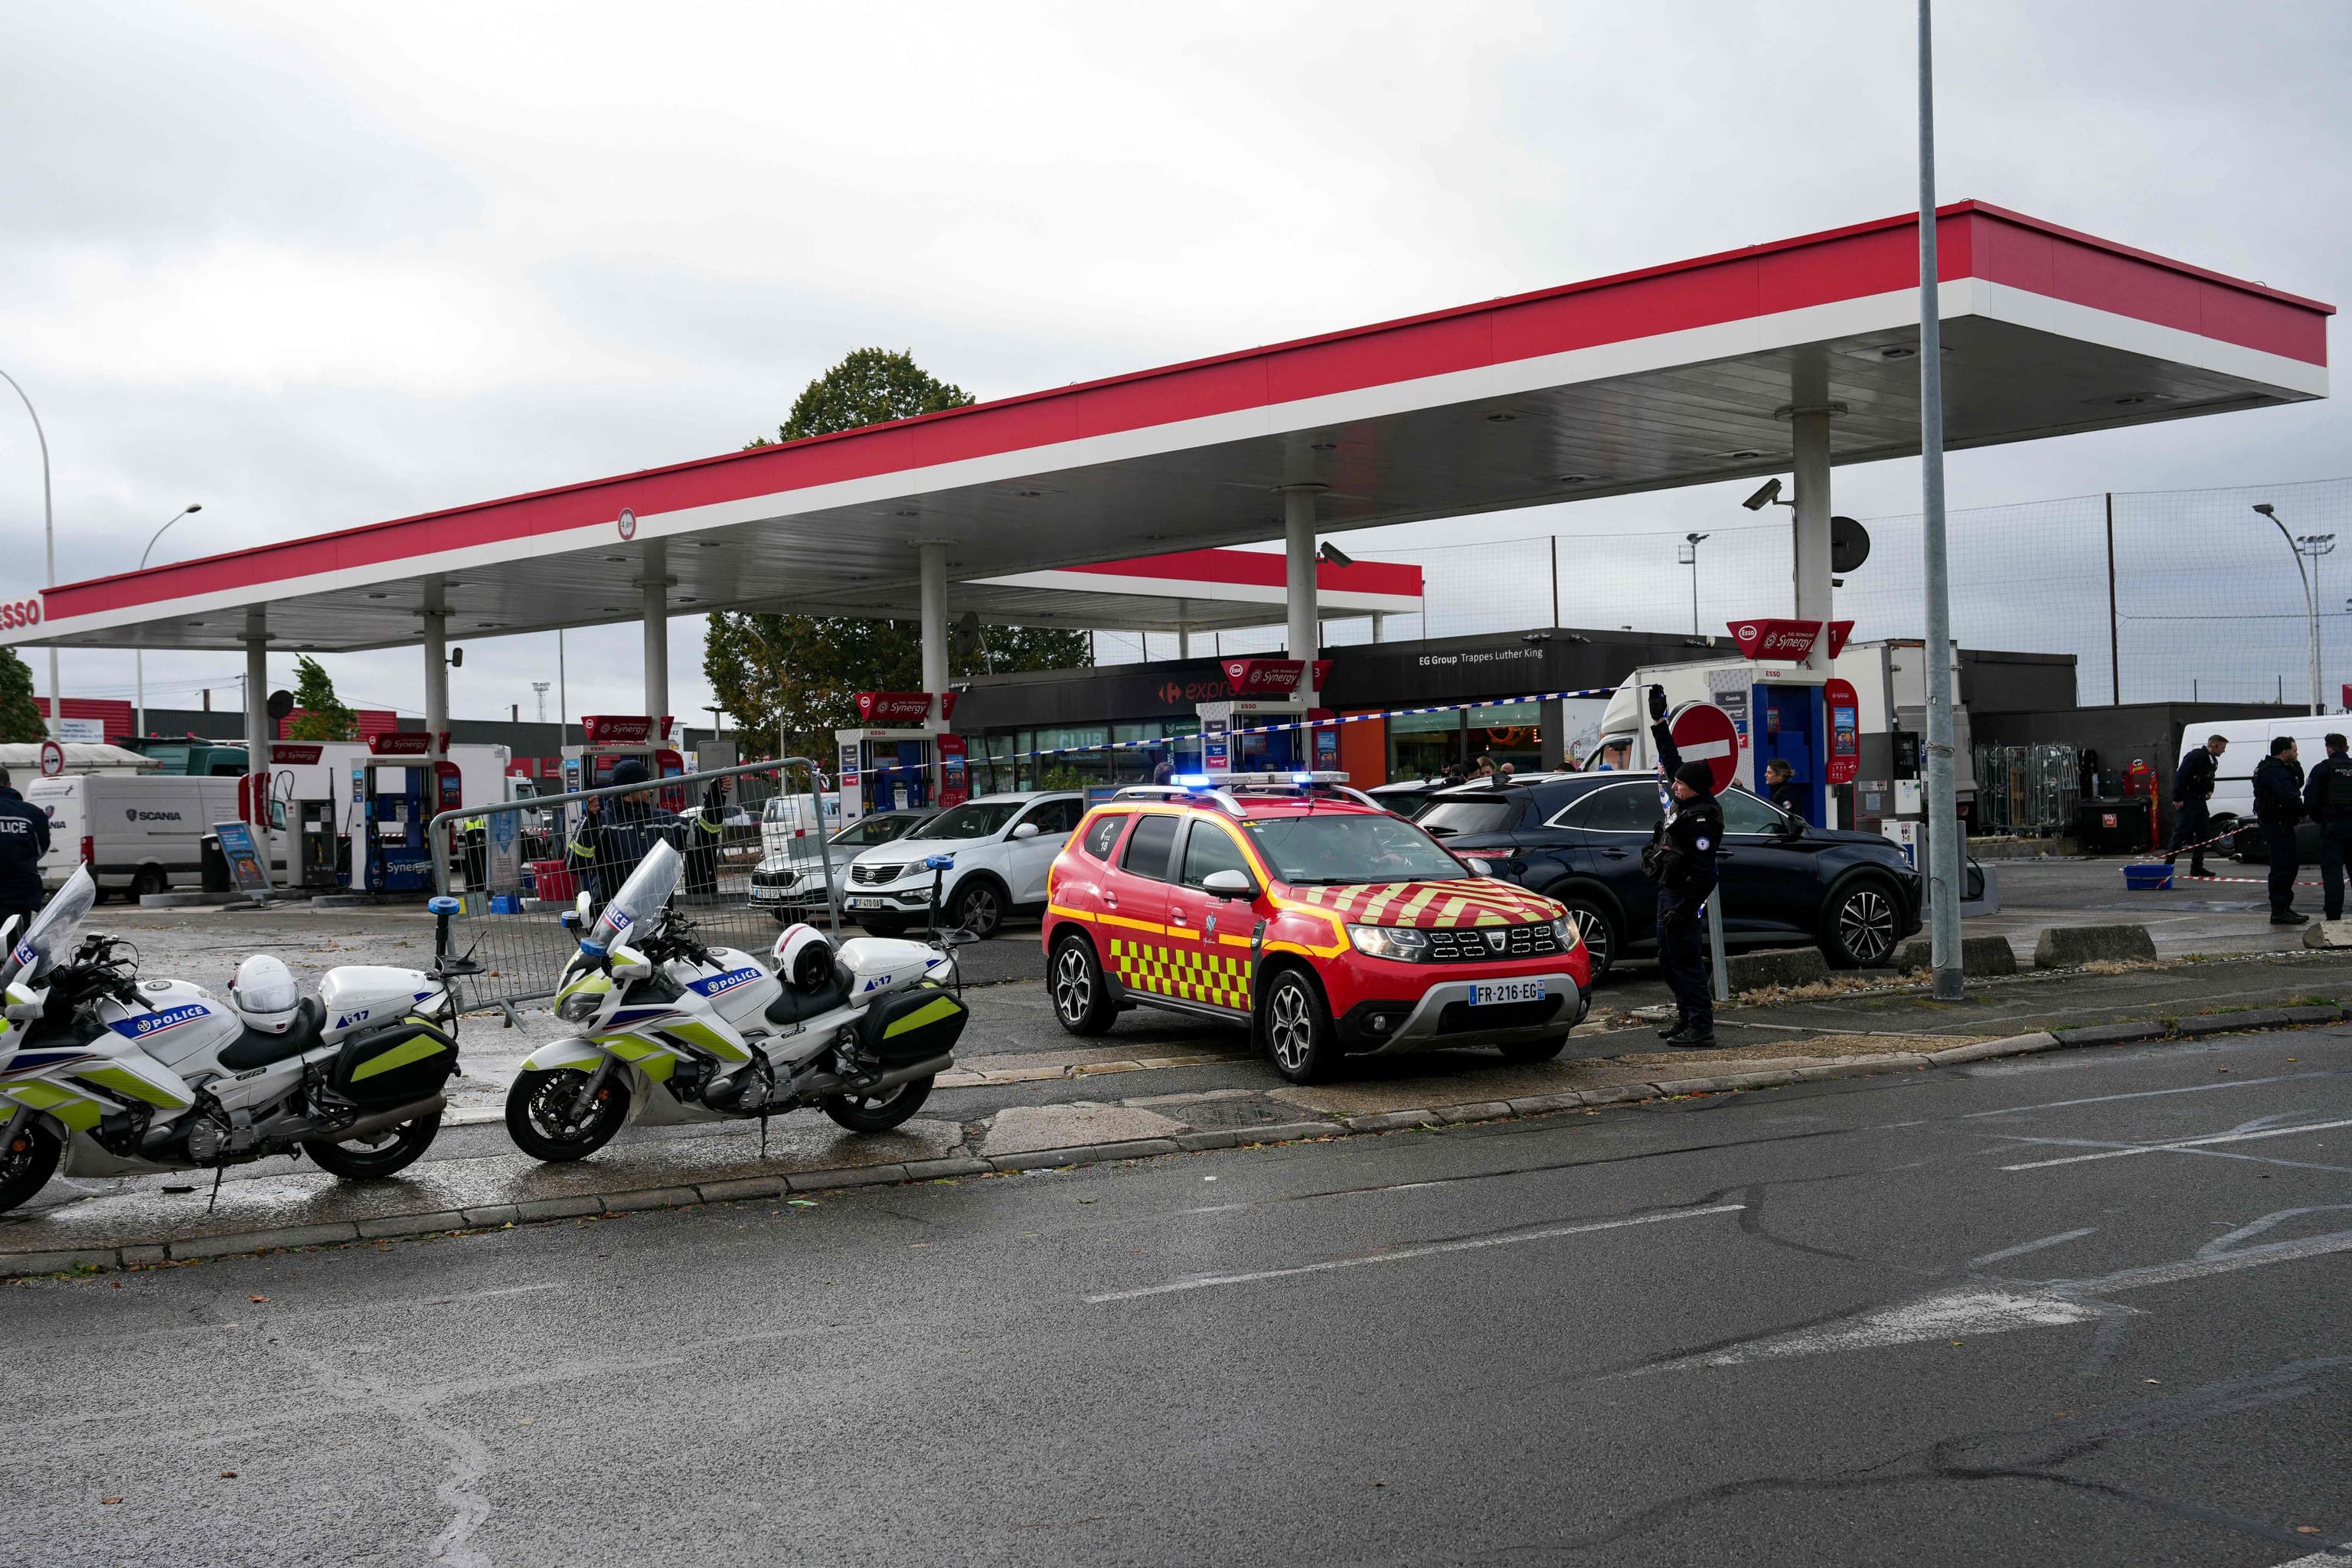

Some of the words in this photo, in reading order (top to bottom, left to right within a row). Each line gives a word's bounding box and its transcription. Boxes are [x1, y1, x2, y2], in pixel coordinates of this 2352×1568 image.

[0, 599, 39, 629] SSO
[1831, 630, 1837, 642] 1
[1777, 635, 1811, 651] Synergy
[1419, 657, 1430, 665] EG
[1432, 656, 1458, 665] Group
[1461, 653, 1493, 664] Trappes
[1495, 649, 1522, 660] Luther
[1524, 648, 1543, 658] King
[1263, 671, 1297, 684] Synergy
[1315, 668, 1320, 677] 3
[890, 703, 926, 714] Synergy
[943, 699, 948, 707] 5
[612, 724, 646, 734] Synergy
[394, 740, 426, 750] Synergy
[1060, 733, 1103, 748] CLUB
[139, 812, 181, 821] SCANIA
[0, 822, 28, 834] LICE
[49, 821, 67, 829] NIA
[1101, 841, 1109, 850] 18
[720, 969, 758, 988] POLICE
[878, 975, 892, 985] 17
[1478, 984, 1537, 1002] FR-216-EG
[152, 1005, 204, 1028] POLICE
[352, 1010, 370, 1022] 17
